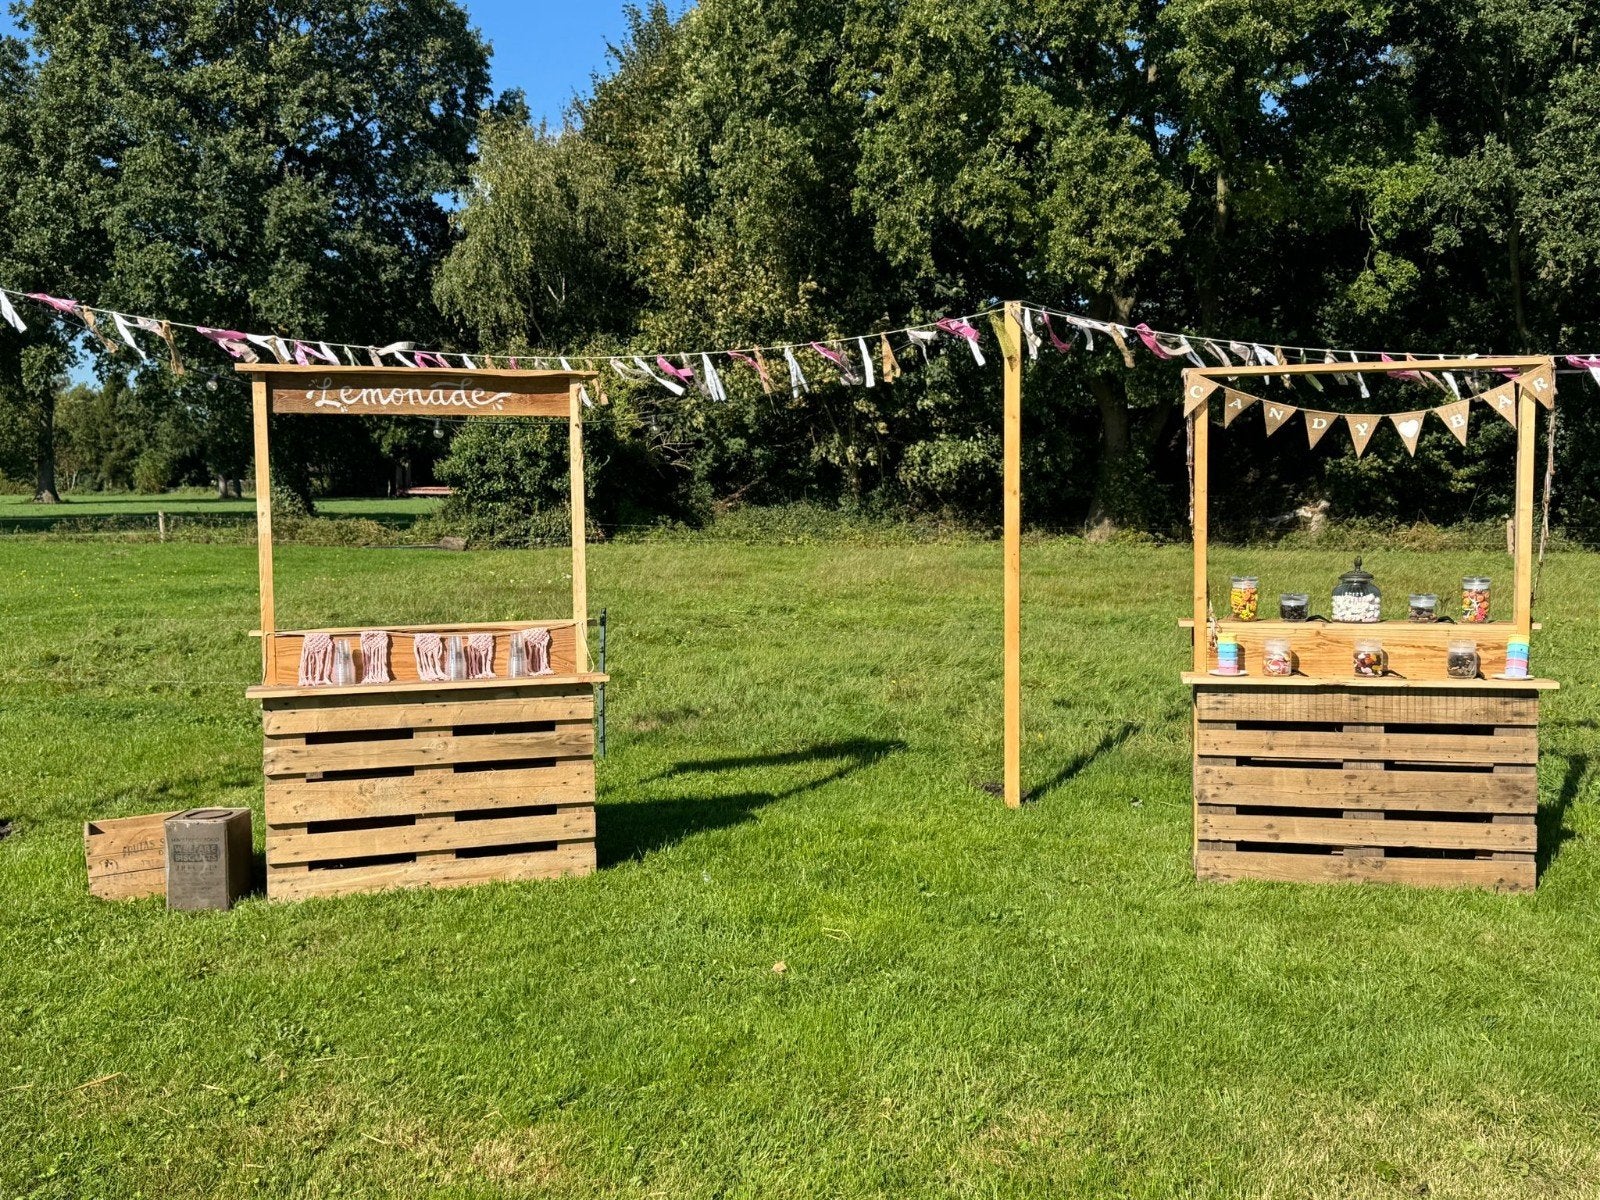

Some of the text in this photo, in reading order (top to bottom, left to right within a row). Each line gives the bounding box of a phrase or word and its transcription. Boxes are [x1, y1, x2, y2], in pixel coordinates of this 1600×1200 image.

[314, 376, 512, 408] Lemonade
[1189, 377, 1549, 436] CANDY BAR
[174, 844, 217, 853] WELFARE
[174, 853, 217, 862] BISCUTS
